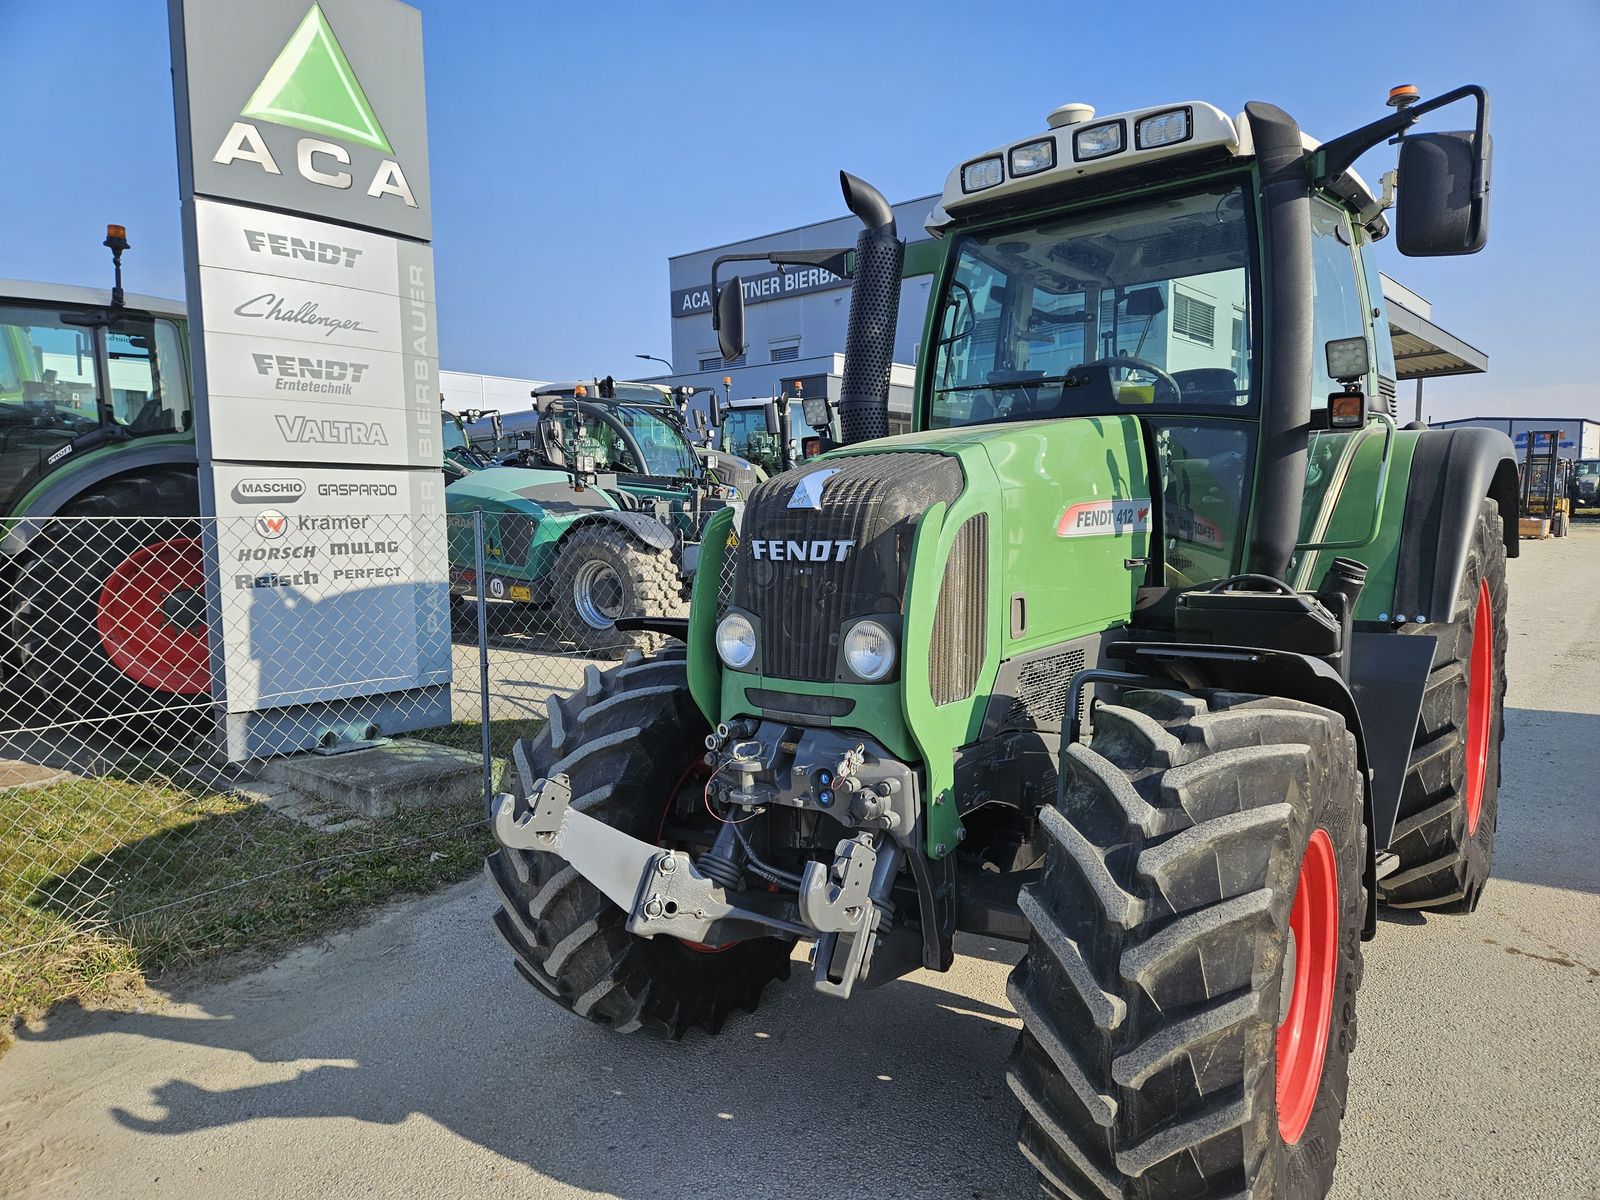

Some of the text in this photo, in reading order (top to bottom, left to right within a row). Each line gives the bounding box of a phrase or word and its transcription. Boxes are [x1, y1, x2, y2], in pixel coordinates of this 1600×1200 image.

[212, 121, 419, 208] ACA
[243, 229, 364, 268] FENDT
[682, 291, 711, 310] ACA
[784, 266, 842, 291] BIERBA
[233, 293, 379, 337] Challenger
[251, 353, 370, 383] FENDT
[408, 264, 433, 458] BIERBAUER
[275, 377, 353, 396] Erntetechnik
[274, 414, 389, 446] VALTRA
[241, 482, 398, 497] MASCHIO GASPARDO
[1076, 509, 1114, 528] FENDT
[1116, 508, 1133, 525] 412
[237, 545, 317, 562] HORSCH
[752, 539, 857, 562] FENDT
[235, 566, 400, 590] Reisch PERFECT
[492, 581, 502, 596] 40
